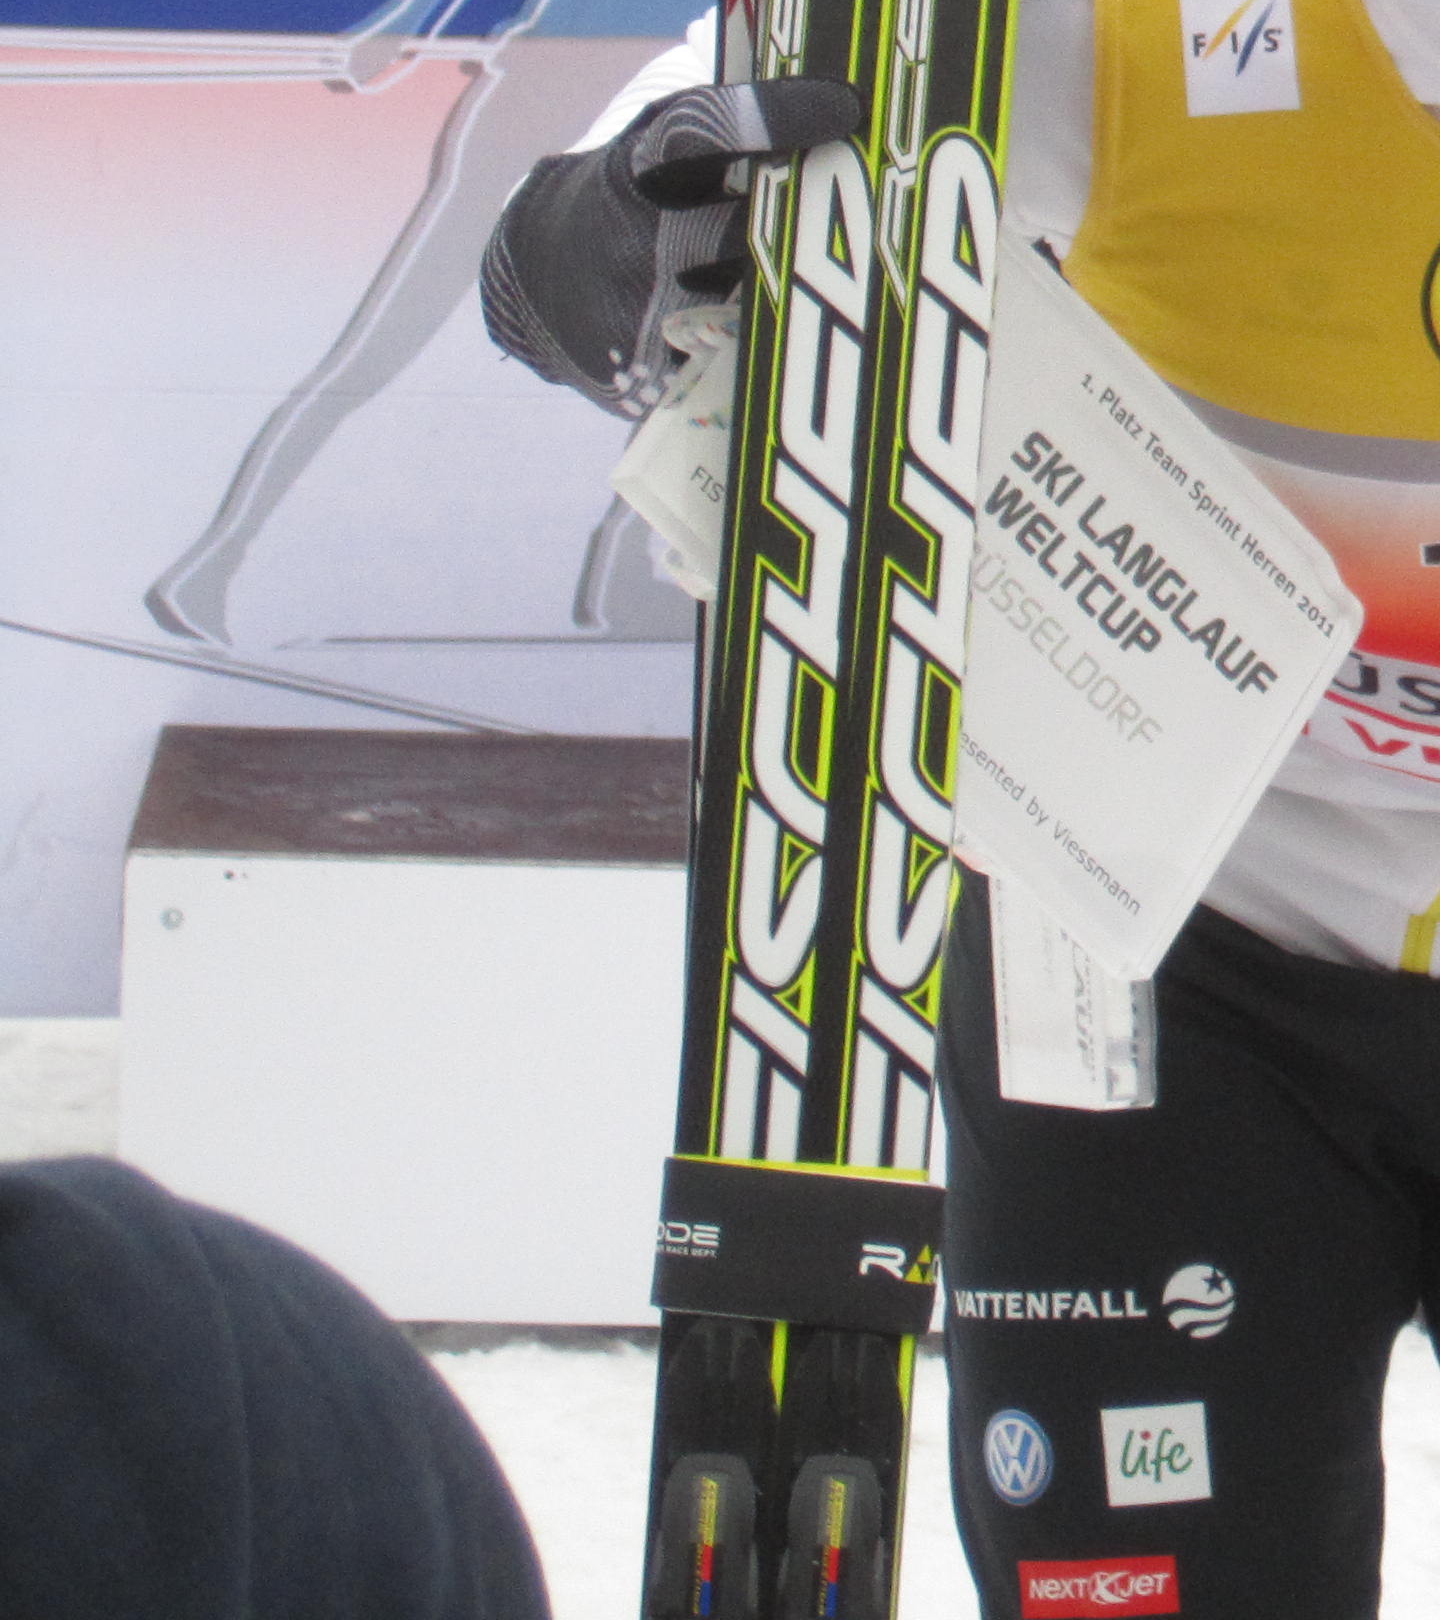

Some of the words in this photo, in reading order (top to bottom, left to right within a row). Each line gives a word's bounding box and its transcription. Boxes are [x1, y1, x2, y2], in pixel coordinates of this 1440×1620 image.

[1193, 26, 1282, 58] FIS
[984, 474, 1162, 658] WELTCUP
[1010, 430, 1084, 508] SKI
[1077, 494, 1279, 694] LANGLAUF
[1098, 388, 1144, 435] Platz
[1144, 428, 1188, 487] Team
[1188, 475, 1242, 544] Sprint
[1241, 526, 1299, 598] Herren
[1296, 594, 1336, 639] 2011
[1026, 794, 1050, 827] by
[1053, 820, 1143, 917] Viessmann
[955, 1289, 1148, 1321] VATTENFALL
[1119, 1429, 1193, 1483] life
